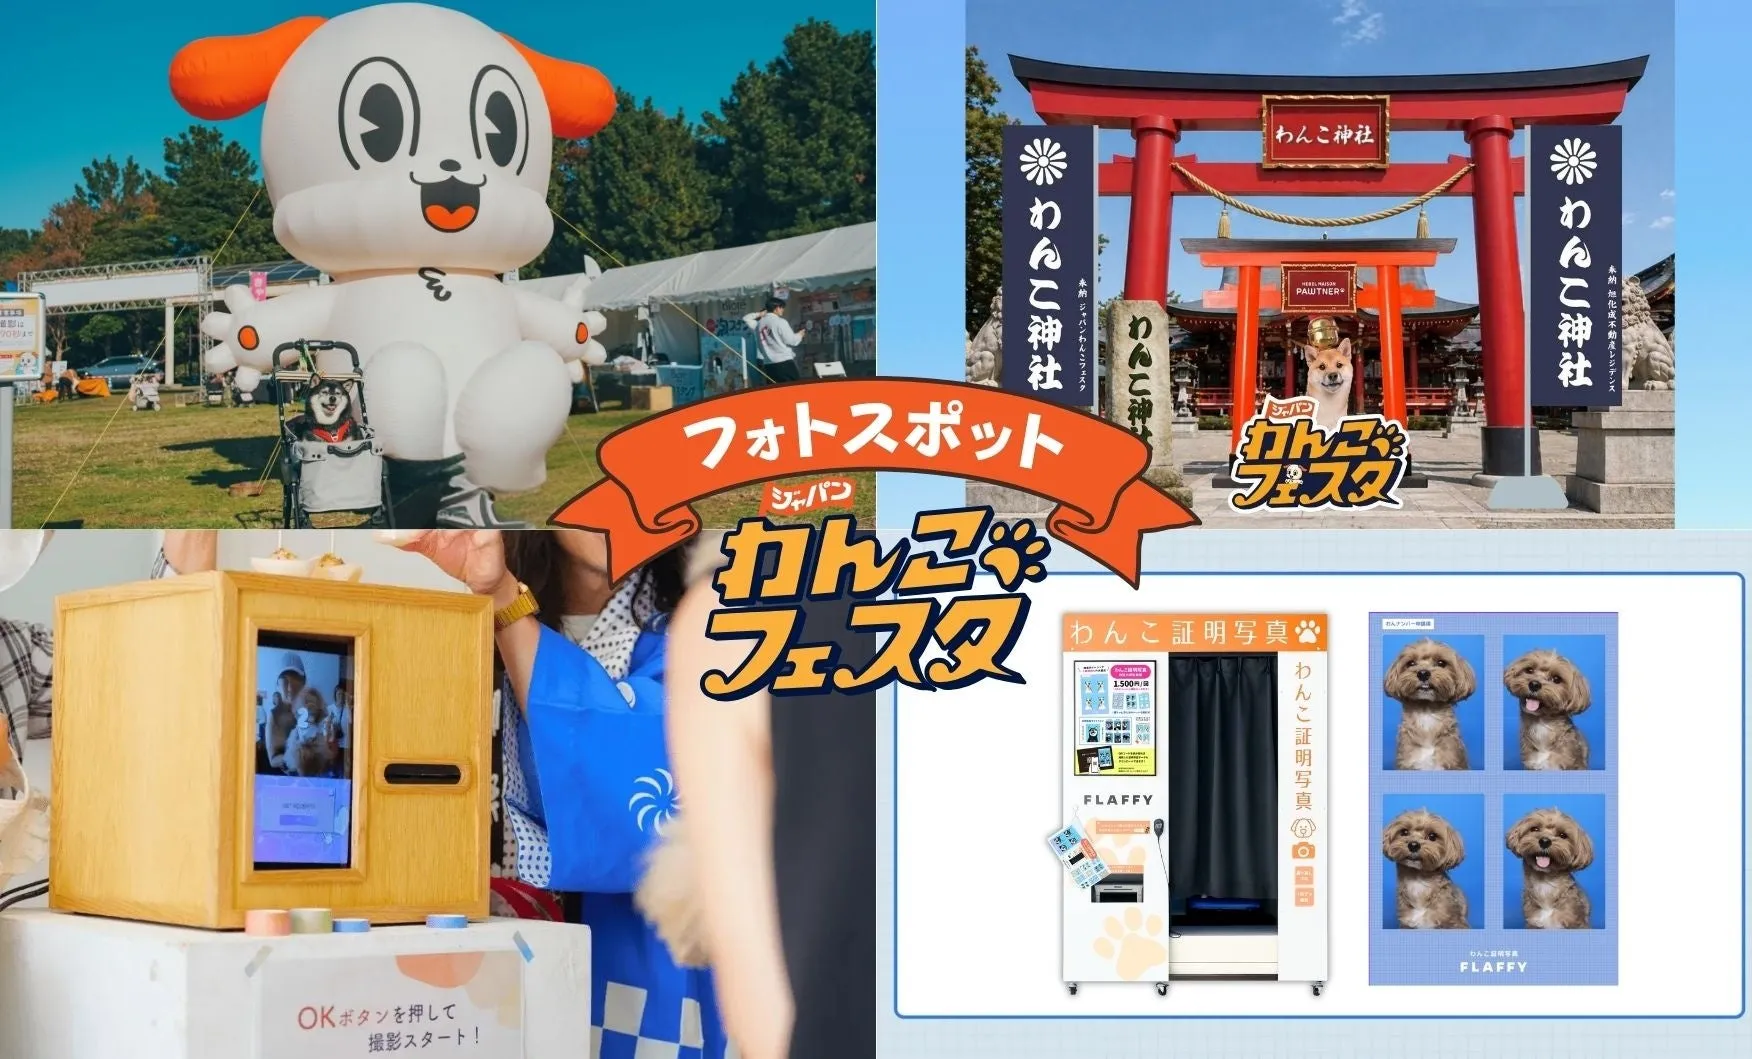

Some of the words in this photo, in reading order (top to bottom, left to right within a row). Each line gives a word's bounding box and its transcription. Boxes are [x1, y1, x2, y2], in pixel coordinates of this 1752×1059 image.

[1275, 124, 1375, 145] わんこ神社
[1027, 197, 1063, 391] わんこ神社
[1295, 287, 1341, 296] PAWTNER
[1557, 196, 1593, 388] わんこ神社
[1078, 302, 1088, 392] ジャパンわんこフェスタ
[1606, 289, 1617, 393] 旭化成不動産レジデンス
[1271, 401, 1314, 418] ジャパン
[1241, 418, 1378, 462] わんこ
[1232, 459, 1401, 509] フェスタ
[1070, 620, 1289, 645] わんこ証明写真
[1294, 661, 1313, 811] わんこ証明写真
[1083, 794, 1153, 805] FLAFFY
[1460, 961, 1527, 973] FLAFFY
[297, 1003, 456, 1030] OKボタンを押して
